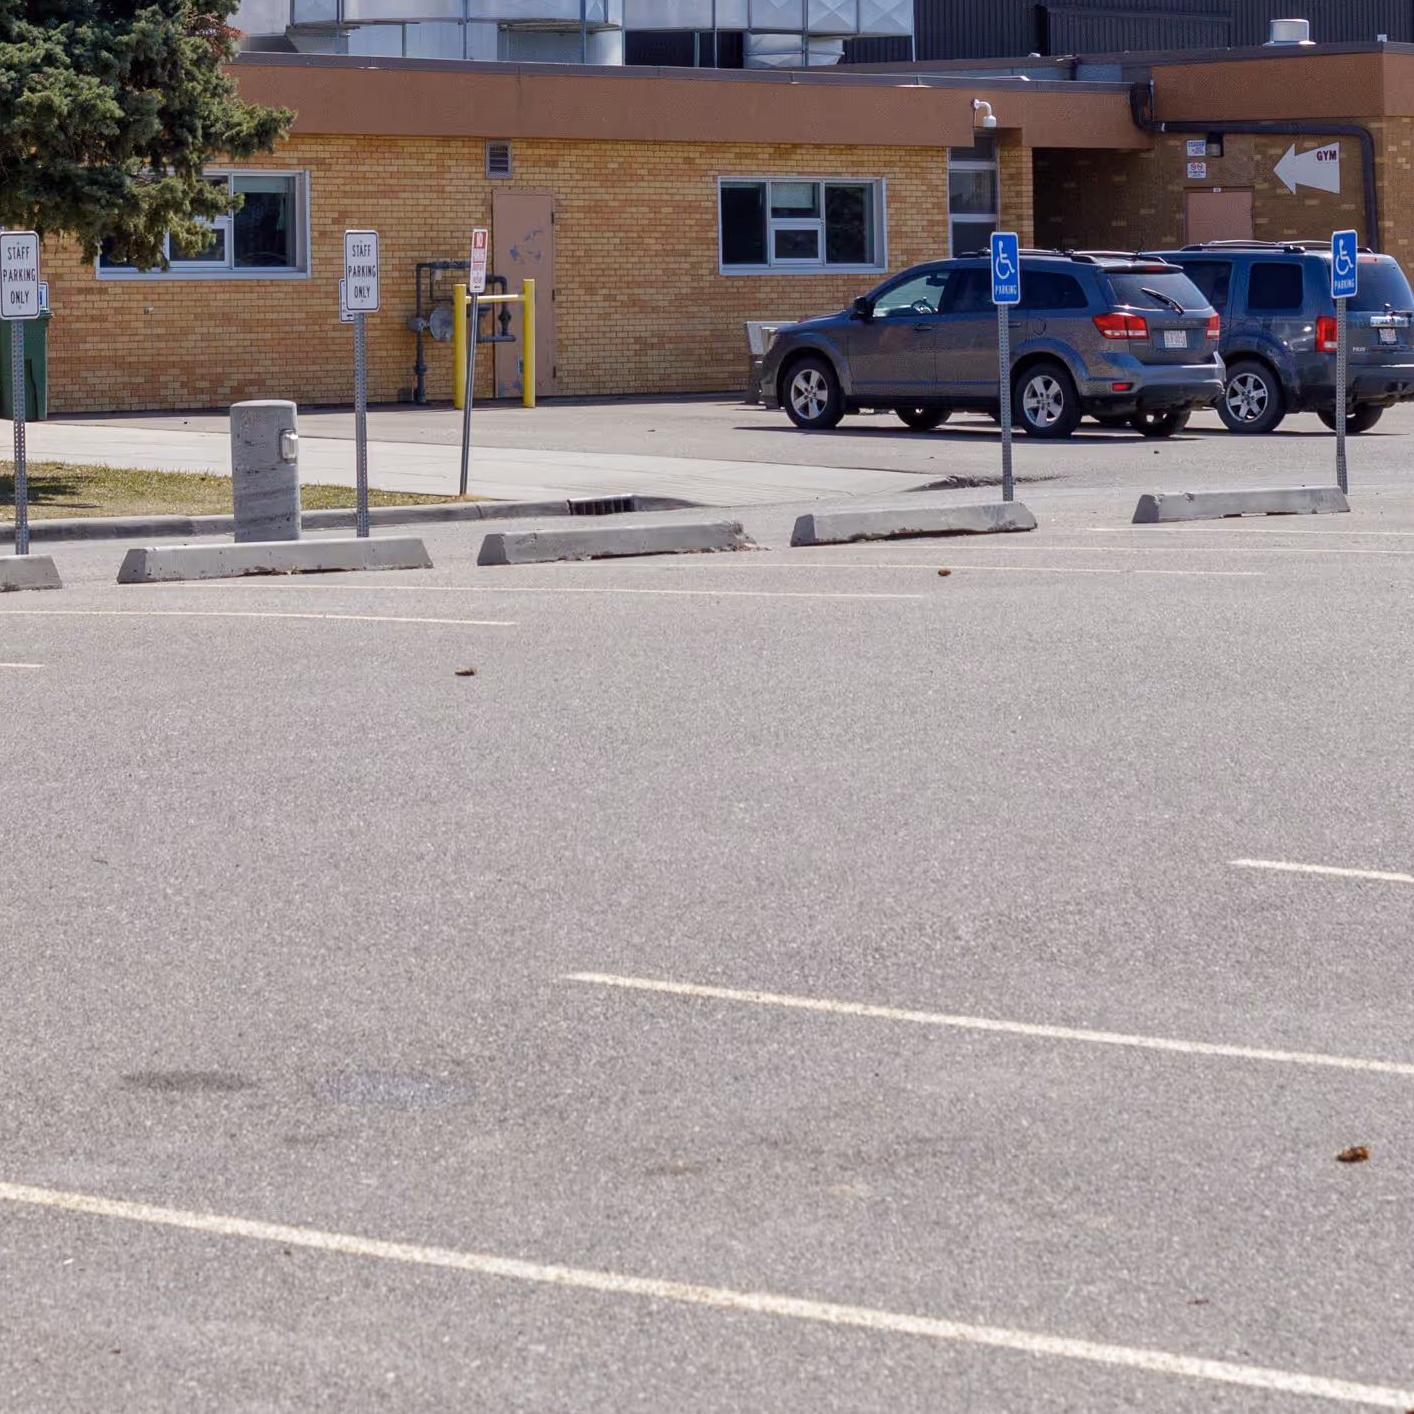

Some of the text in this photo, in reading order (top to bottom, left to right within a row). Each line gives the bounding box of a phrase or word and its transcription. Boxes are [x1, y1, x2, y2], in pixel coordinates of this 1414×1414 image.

[1316, 150, 1337, 161] GYM
[7, 246, 30, 260] STAFF
[352, 244, 371, 257] STAFF
[3, 269, 36, 283] PARKING
[348, 265, 376, 278] PARKING
[995, 284, 1018, 295] PARKING
[1334, 278, 1355, 290] PARKING
[10, 290, 30, 304] ONLY
[354, 285, 371, 299] ONLY
